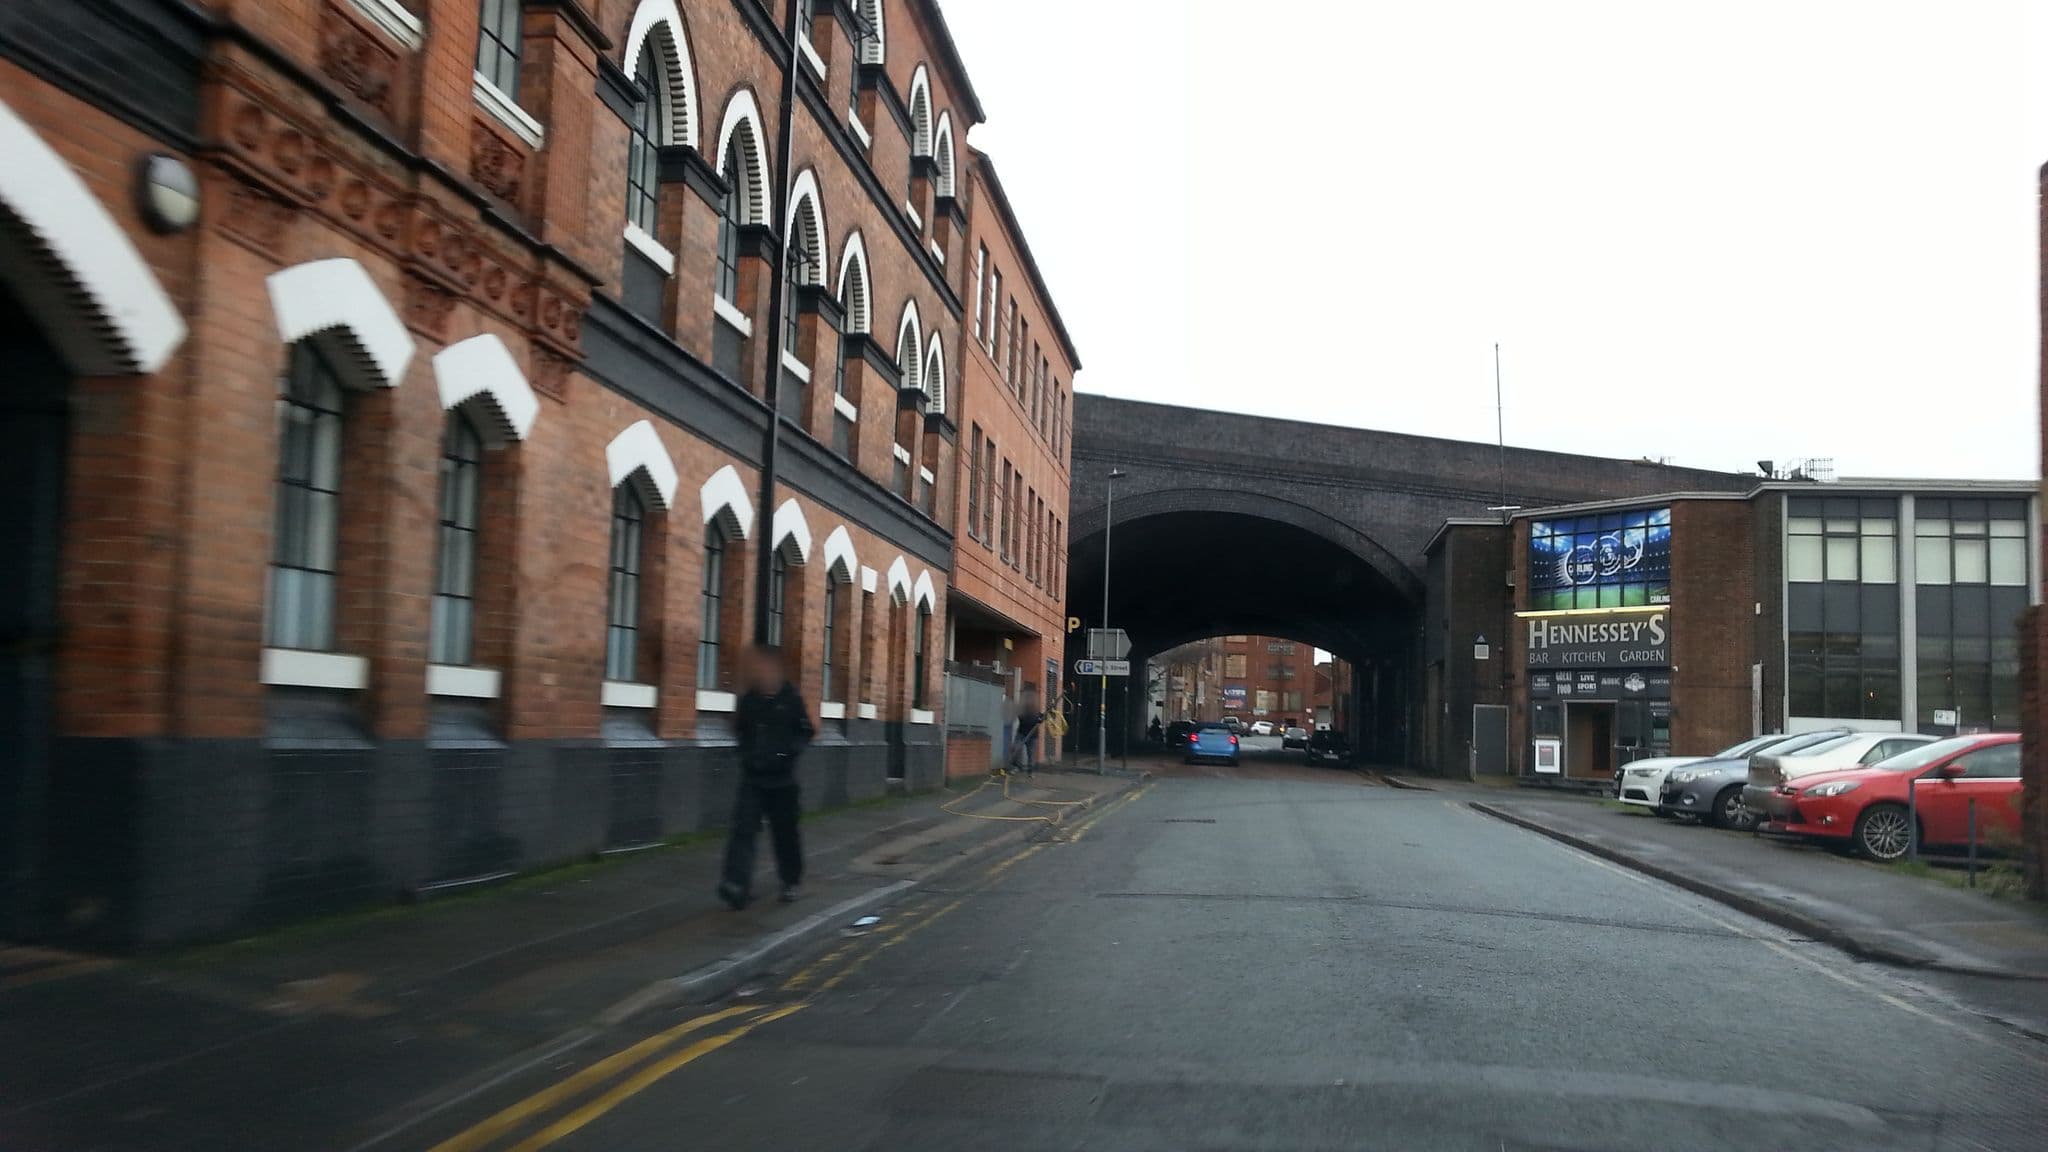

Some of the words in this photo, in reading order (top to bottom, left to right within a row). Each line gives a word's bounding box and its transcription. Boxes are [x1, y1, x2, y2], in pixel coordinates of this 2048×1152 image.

[1068, 617, 1080, 633] P
[1529, 614, 1665, 648] HENNESSEY'S
[1529, 652, 1549, 664] BAR
[1562, 651, 1606, 663] KITCHEN
[1620, 650, 1665, 663] GARDEN
[1580, 674, 1595, 682] LIVE
[1577, 682, 1597, 690] SPORT
